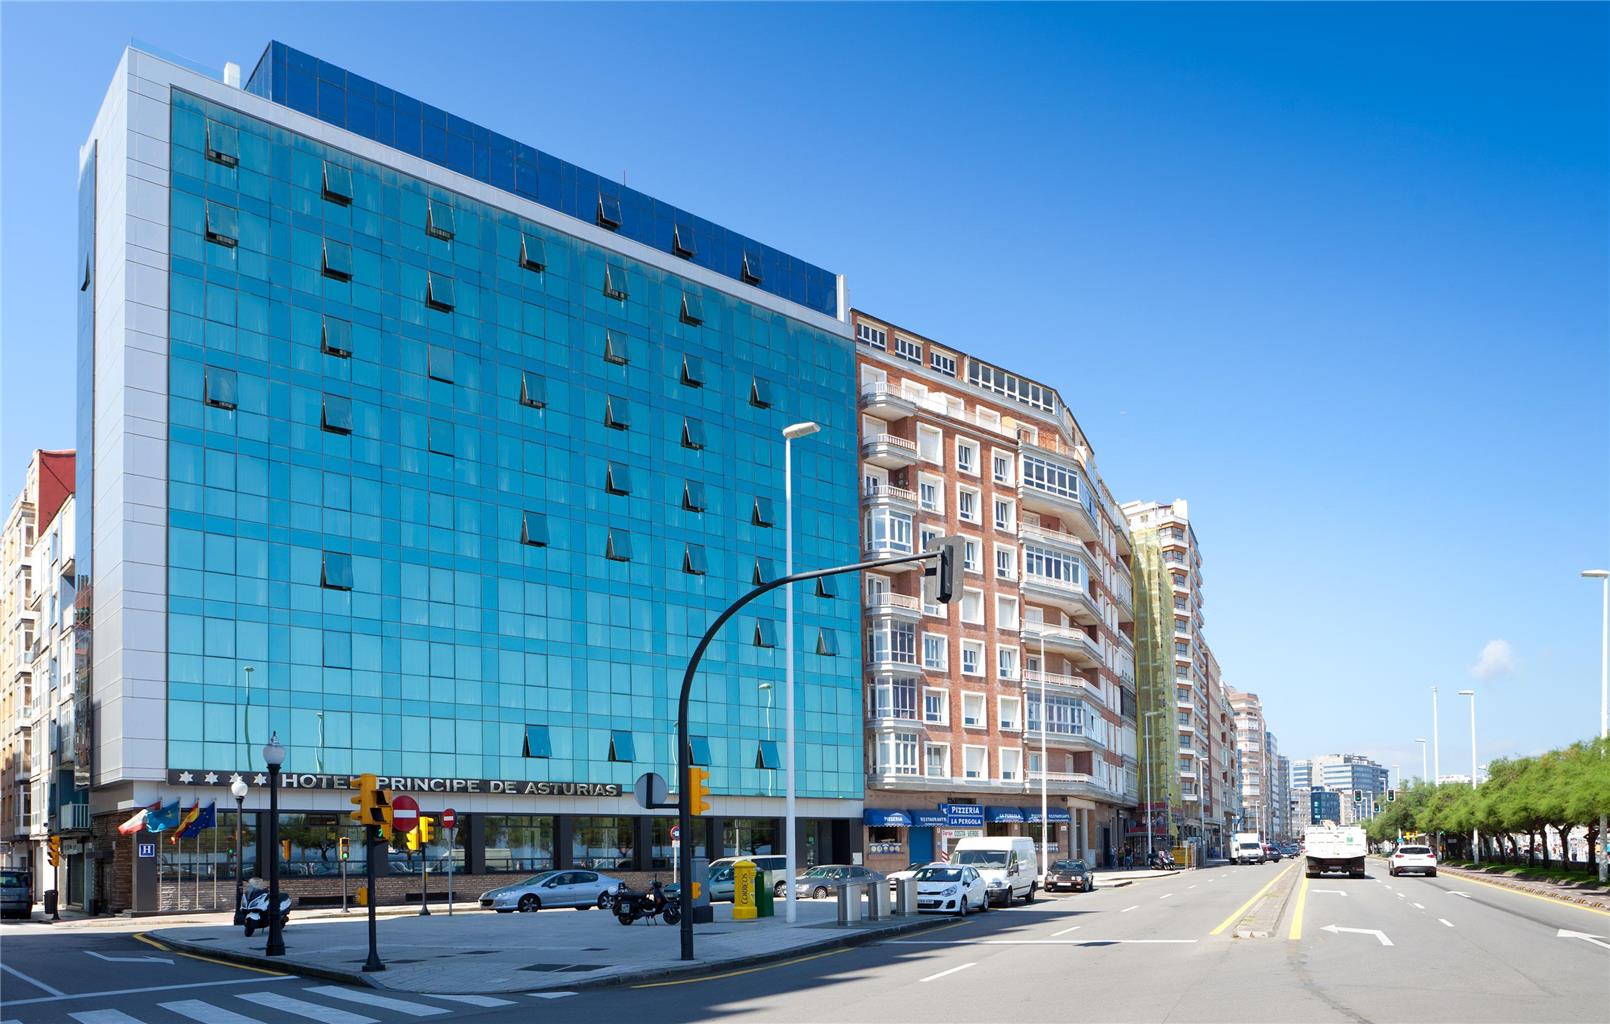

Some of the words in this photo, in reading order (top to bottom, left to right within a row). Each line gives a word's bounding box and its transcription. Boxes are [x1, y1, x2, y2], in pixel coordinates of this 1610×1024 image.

[281, 773, 360, 790] HOTEL
[376, 776, 481, 793] PRINCIPE
[489, 780, 517, 794] DE
[524, 781, 618, 797] ASTURIAS
[951, 806, 980, 815] PIZZERIA
[143, 845, 151, 854] H
